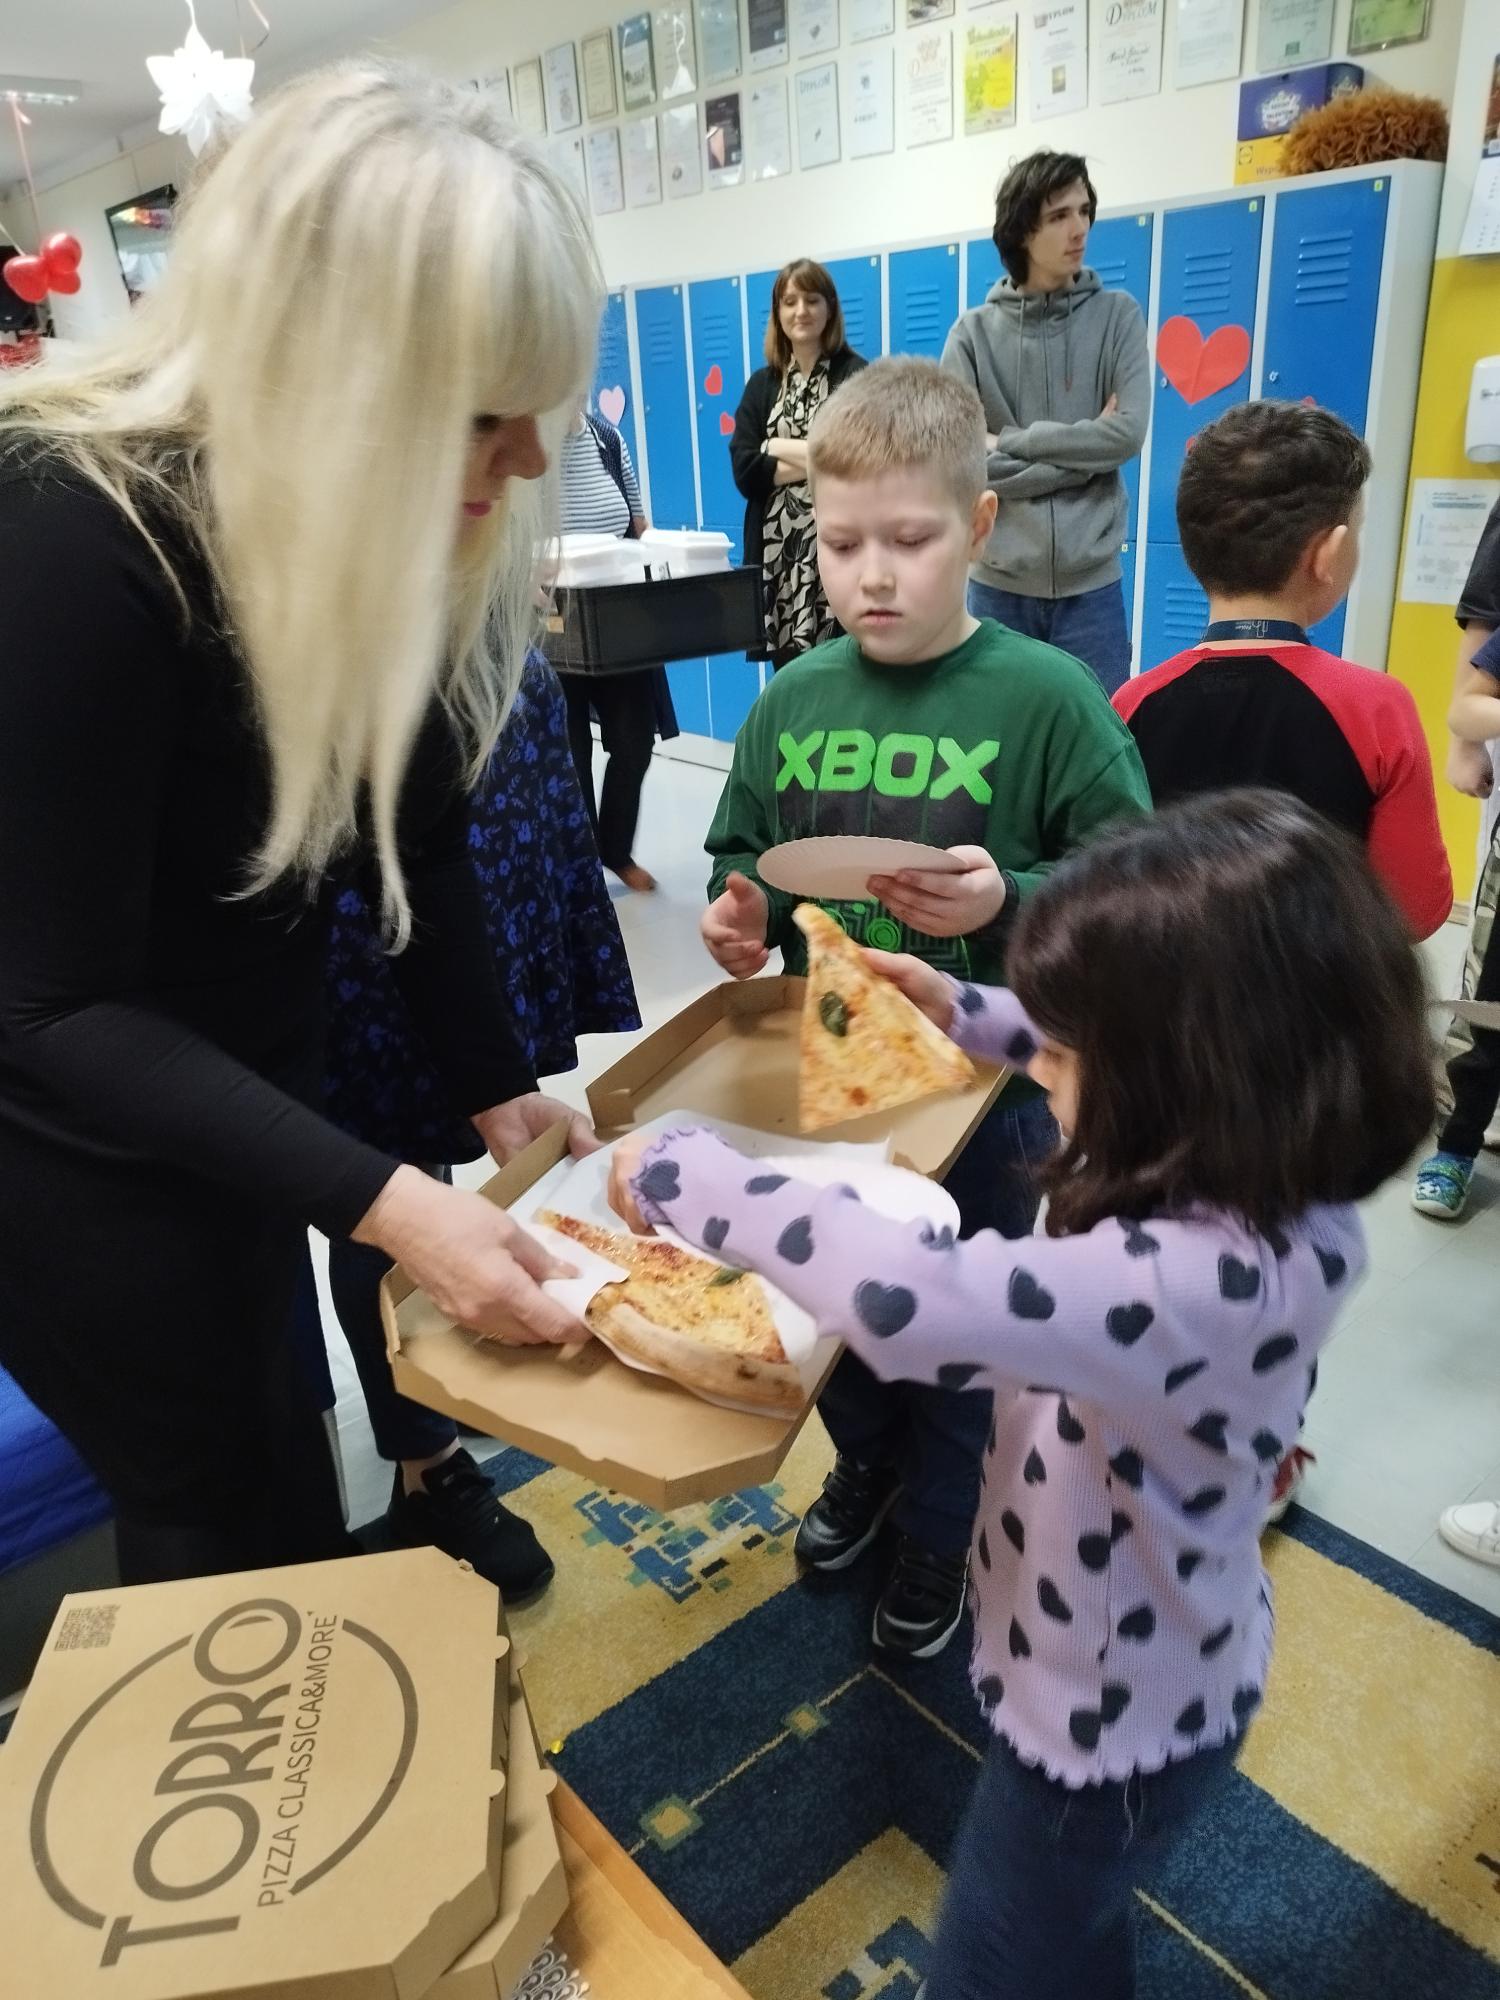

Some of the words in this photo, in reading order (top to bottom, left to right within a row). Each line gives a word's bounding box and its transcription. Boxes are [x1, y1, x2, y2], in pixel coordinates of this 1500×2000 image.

[775, 729, 1000, 805] XBOX
[99, 1598, 302, 1968] TORRO
[277, 1614, 338, 1820] CLASSICA&MORE
[257, 1824, 300, 1908] PIZZA
